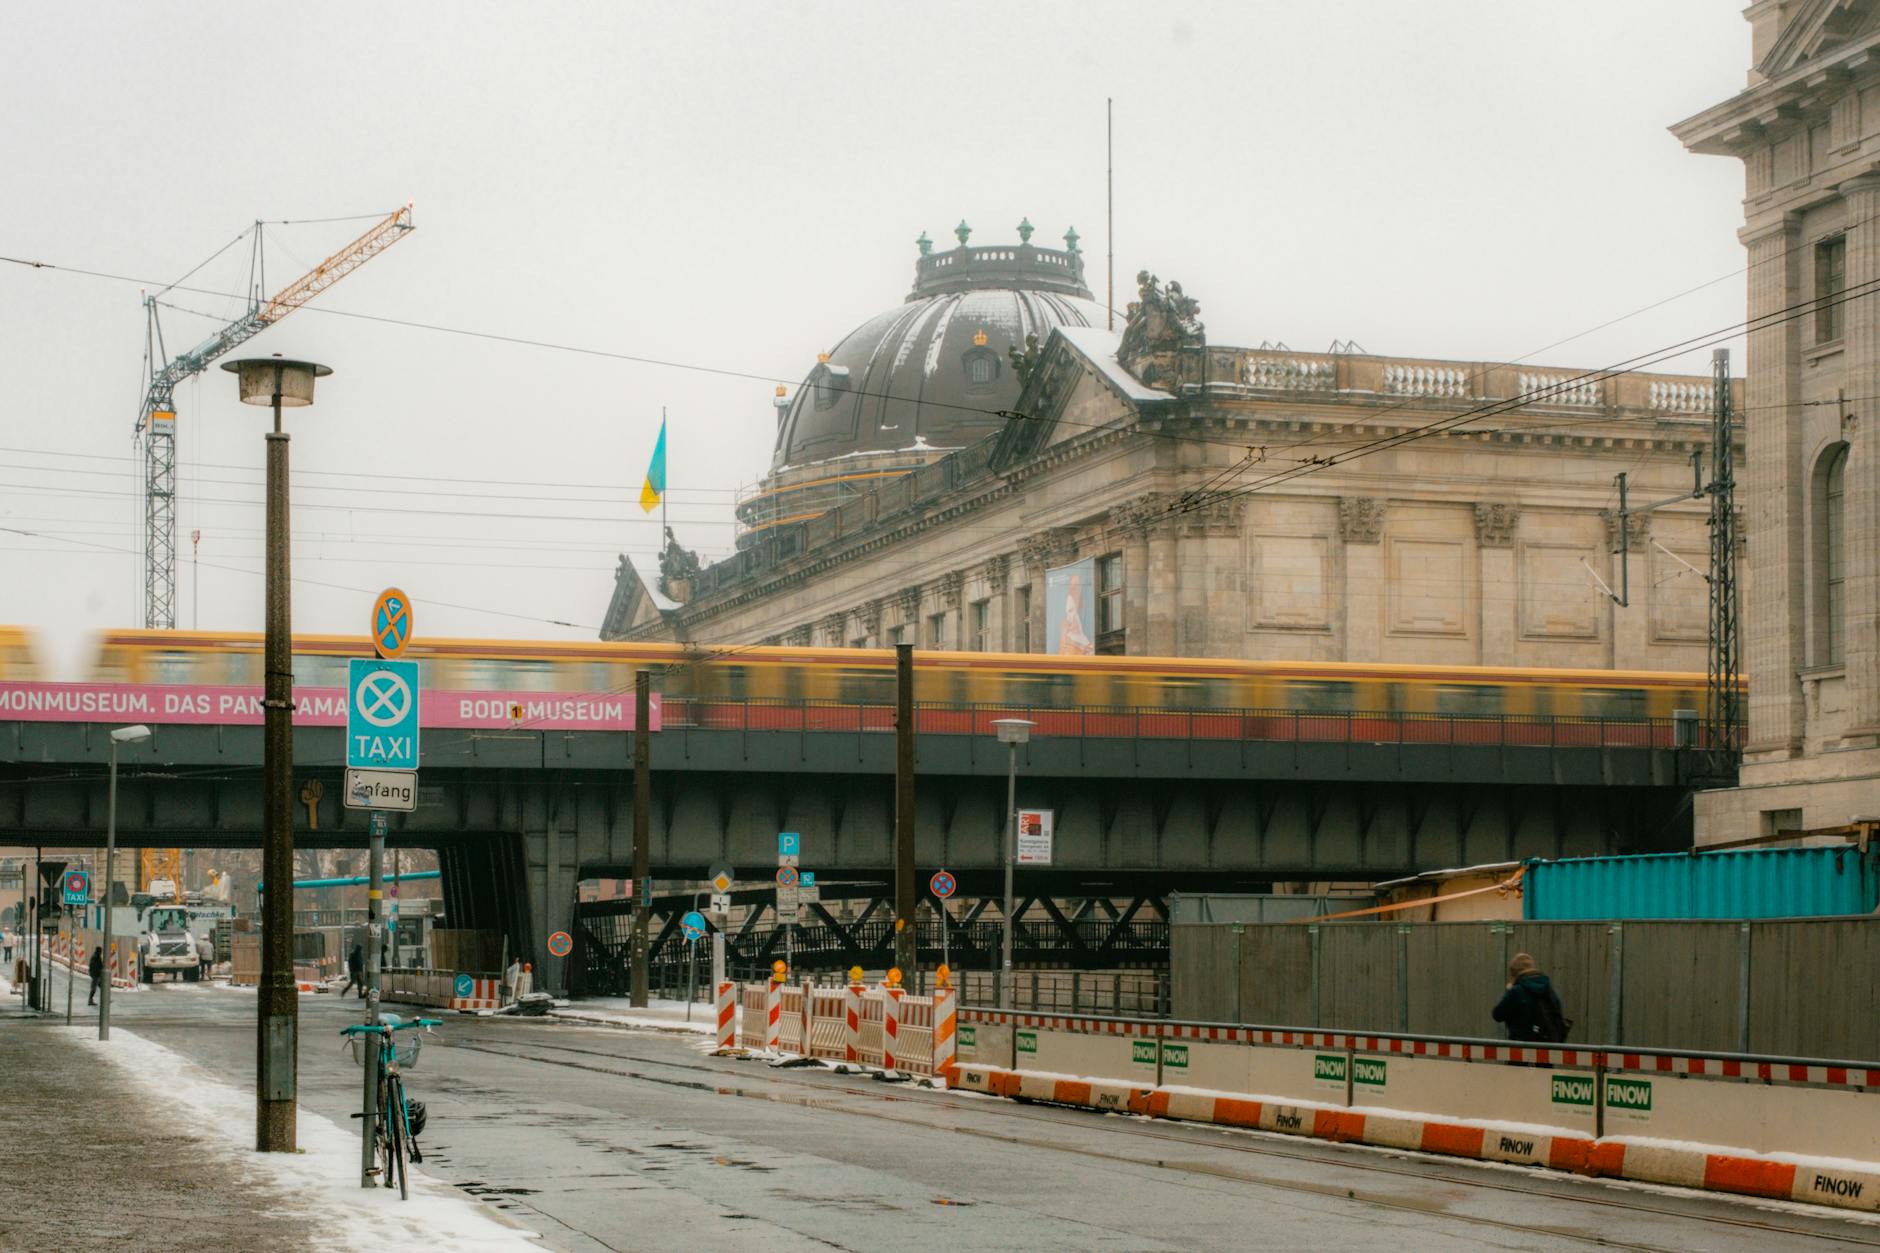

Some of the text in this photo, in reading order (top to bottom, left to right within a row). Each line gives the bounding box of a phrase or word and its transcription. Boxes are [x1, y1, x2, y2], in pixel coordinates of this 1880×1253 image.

[165, 694, 211, 714] DAS
[219, 695, 348, 716] PANAMA
[354, 735, 411, 759] TAXI
[354, 781, 411, 802] nfang
[66, 893, 85, 902] TAXI
[1133, 1044, 1156, 1061] FINOW
[1163, 1048, 1188, 1064] FINOW
[1316, 1059, 1346, 1077] FINOW
[1355, 1063, 1386, 1081] FINOW
[1552, 1079, 1593, 1101] FINOW
[1607, 1083, 1650, 1105] FINOW
[1100, 1093, 1120, 1106] FINOW
[1276, 1114, 1302, 1129] FINOW
[1500, 1137, 1534, 1156] FINOW
[1813, 1174, 1863, 1198] FINOW
